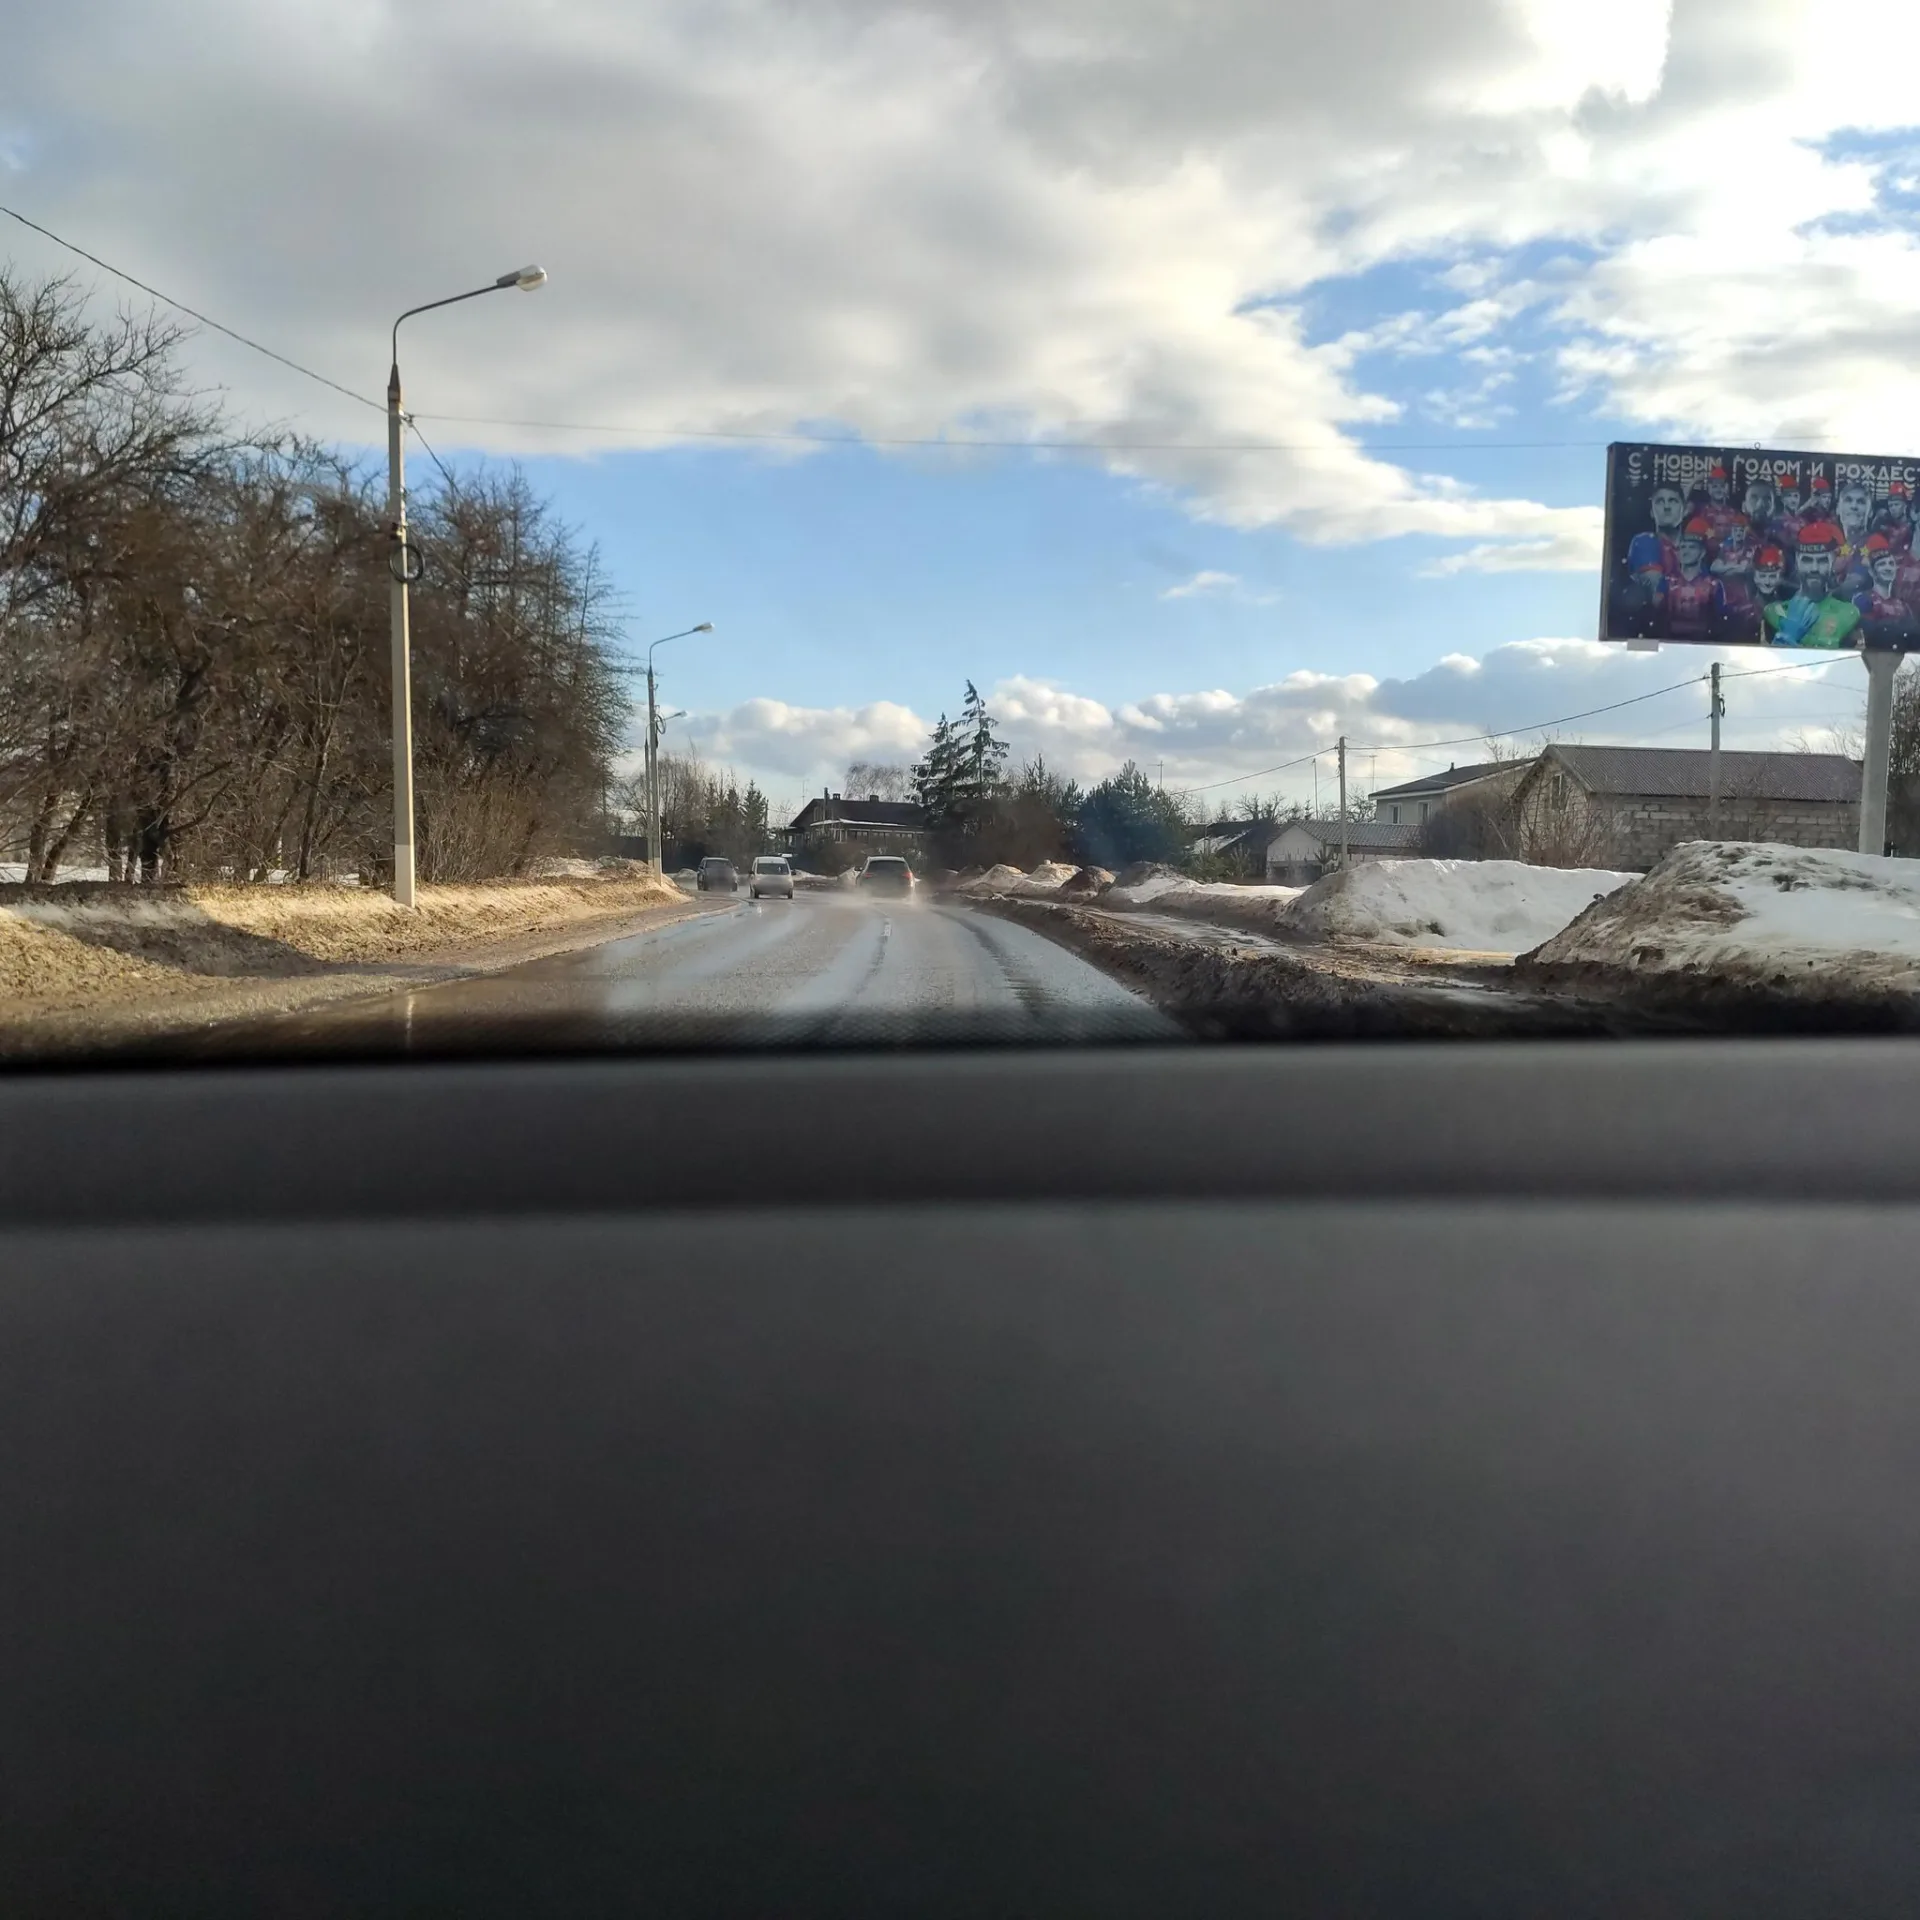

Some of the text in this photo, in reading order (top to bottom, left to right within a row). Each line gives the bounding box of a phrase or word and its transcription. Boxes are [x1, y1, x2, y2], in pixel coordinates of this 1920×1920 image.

[1654, 453, 1723, 471] НОВЫМ
[1732, 455, 1801, 475] ГОДОМ
[1811, 461, 1825, 478] И
[1835, 463, 1920, 482] РОЖДЕС
